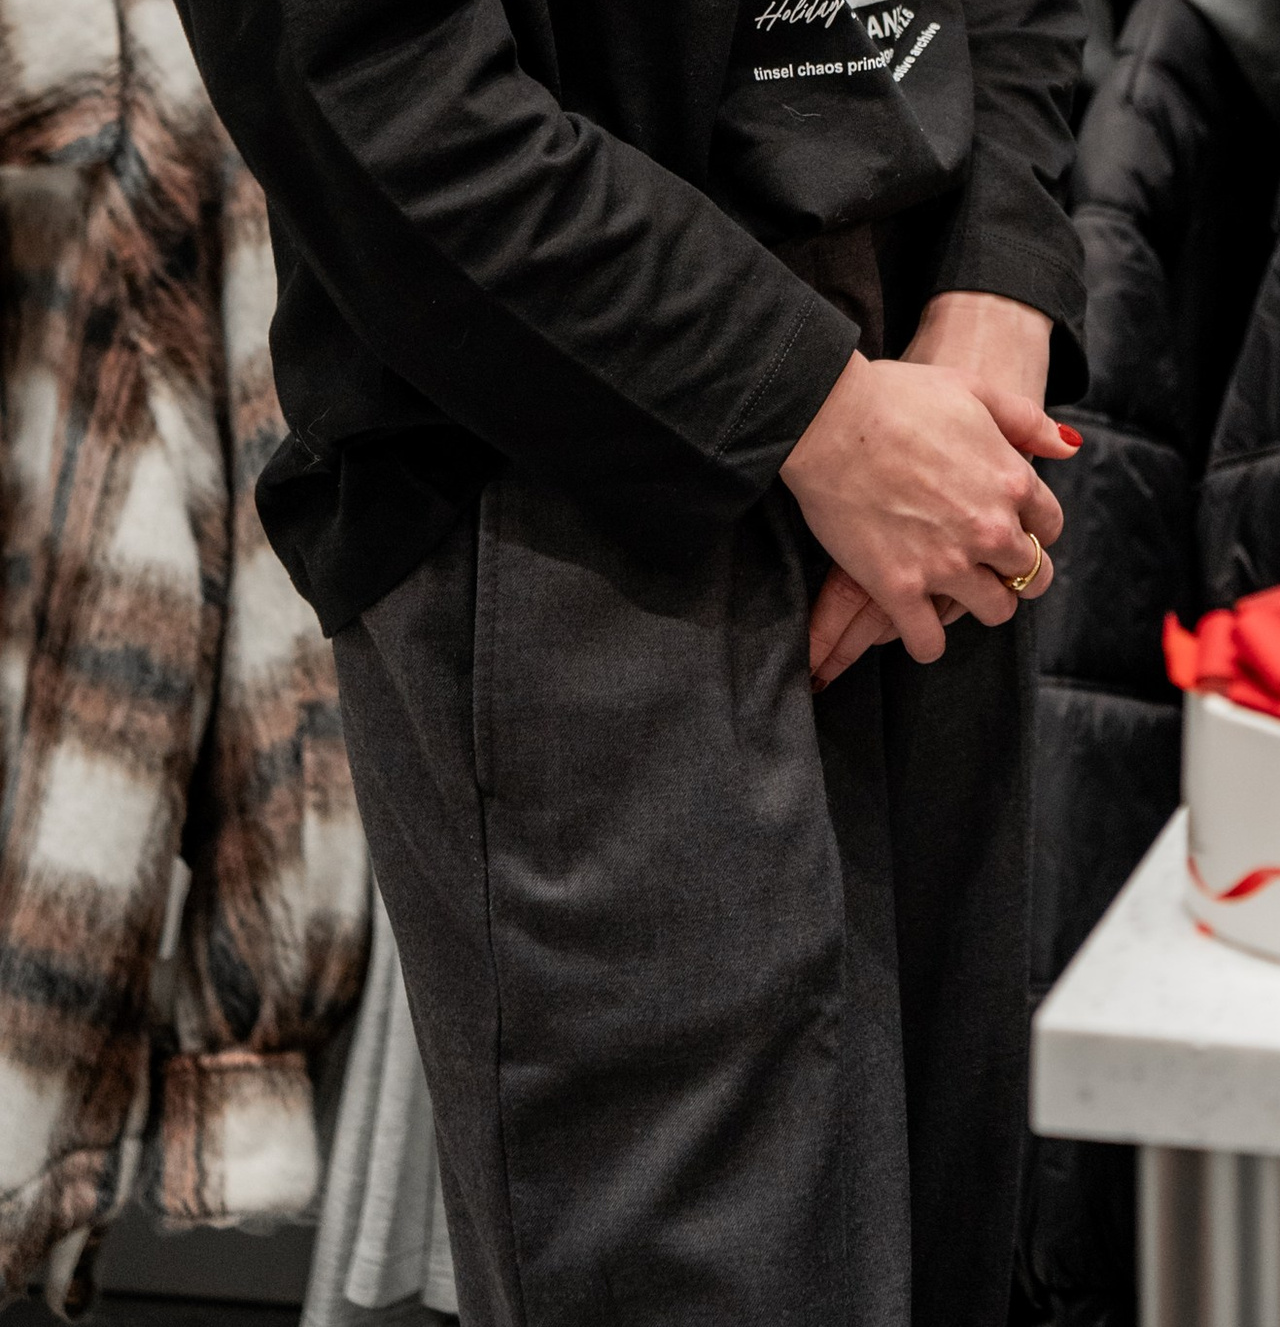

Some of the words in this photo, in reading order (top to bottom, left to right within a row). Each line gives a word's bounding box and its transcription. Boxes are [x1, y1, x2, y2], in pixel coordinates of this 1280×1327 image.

[753, 63, 794, 81] tinsel
[797, 61, 844, 77] chaos
[909, 21, 941, 57] archive
